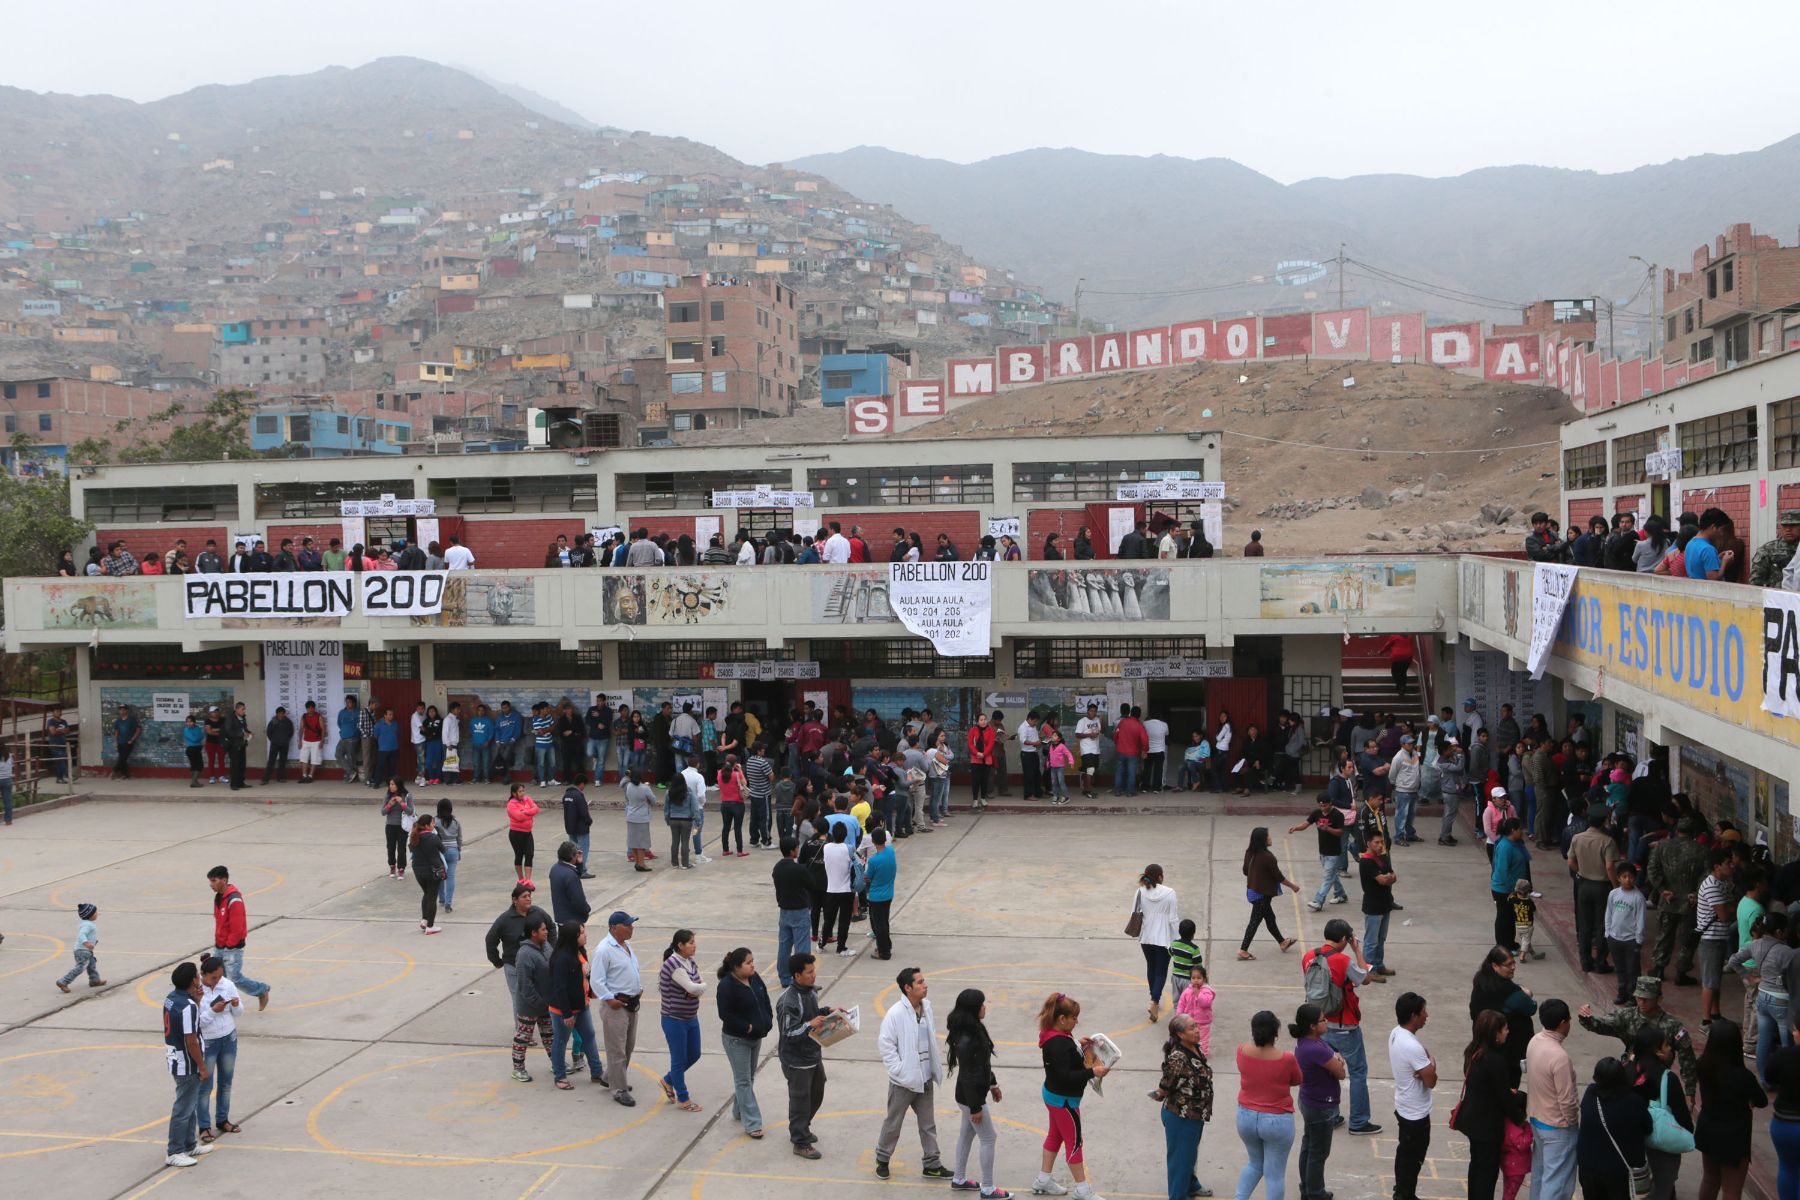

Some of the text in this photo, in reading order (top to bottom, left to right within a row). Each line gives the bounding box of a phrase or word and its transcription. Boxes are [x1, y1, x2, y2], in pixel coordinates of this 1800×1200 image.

[854, 324, 1249, 433] SEMBRANDO
[1165, 483, 1178, 491] 205
[758, 491, 768, 499] 204
[893, 562, 987, 581] PABELLON 200
[187, 574, 444, 614] PABELLON 200
[900, 596, 964, 605] AULA AULA AULA
[922, 607, 938, 616] 204
[944, 607, 961, 616] 205
[921, 618, 964, 627] AULA AULA
[944, 630, 961, 639] 202
[266, 640, 340, 657] PABELLON 200
[1618, 602, 1745, 702] ESTUDIO
[344, 663, 361, 676] MOR
[761, 666, 772, 674] 201
[1085, 663, 1121, 674] AMISTA
[1169, 661, 1181, 670] 202
[1005, 696, 1026, 704] SALIDA
